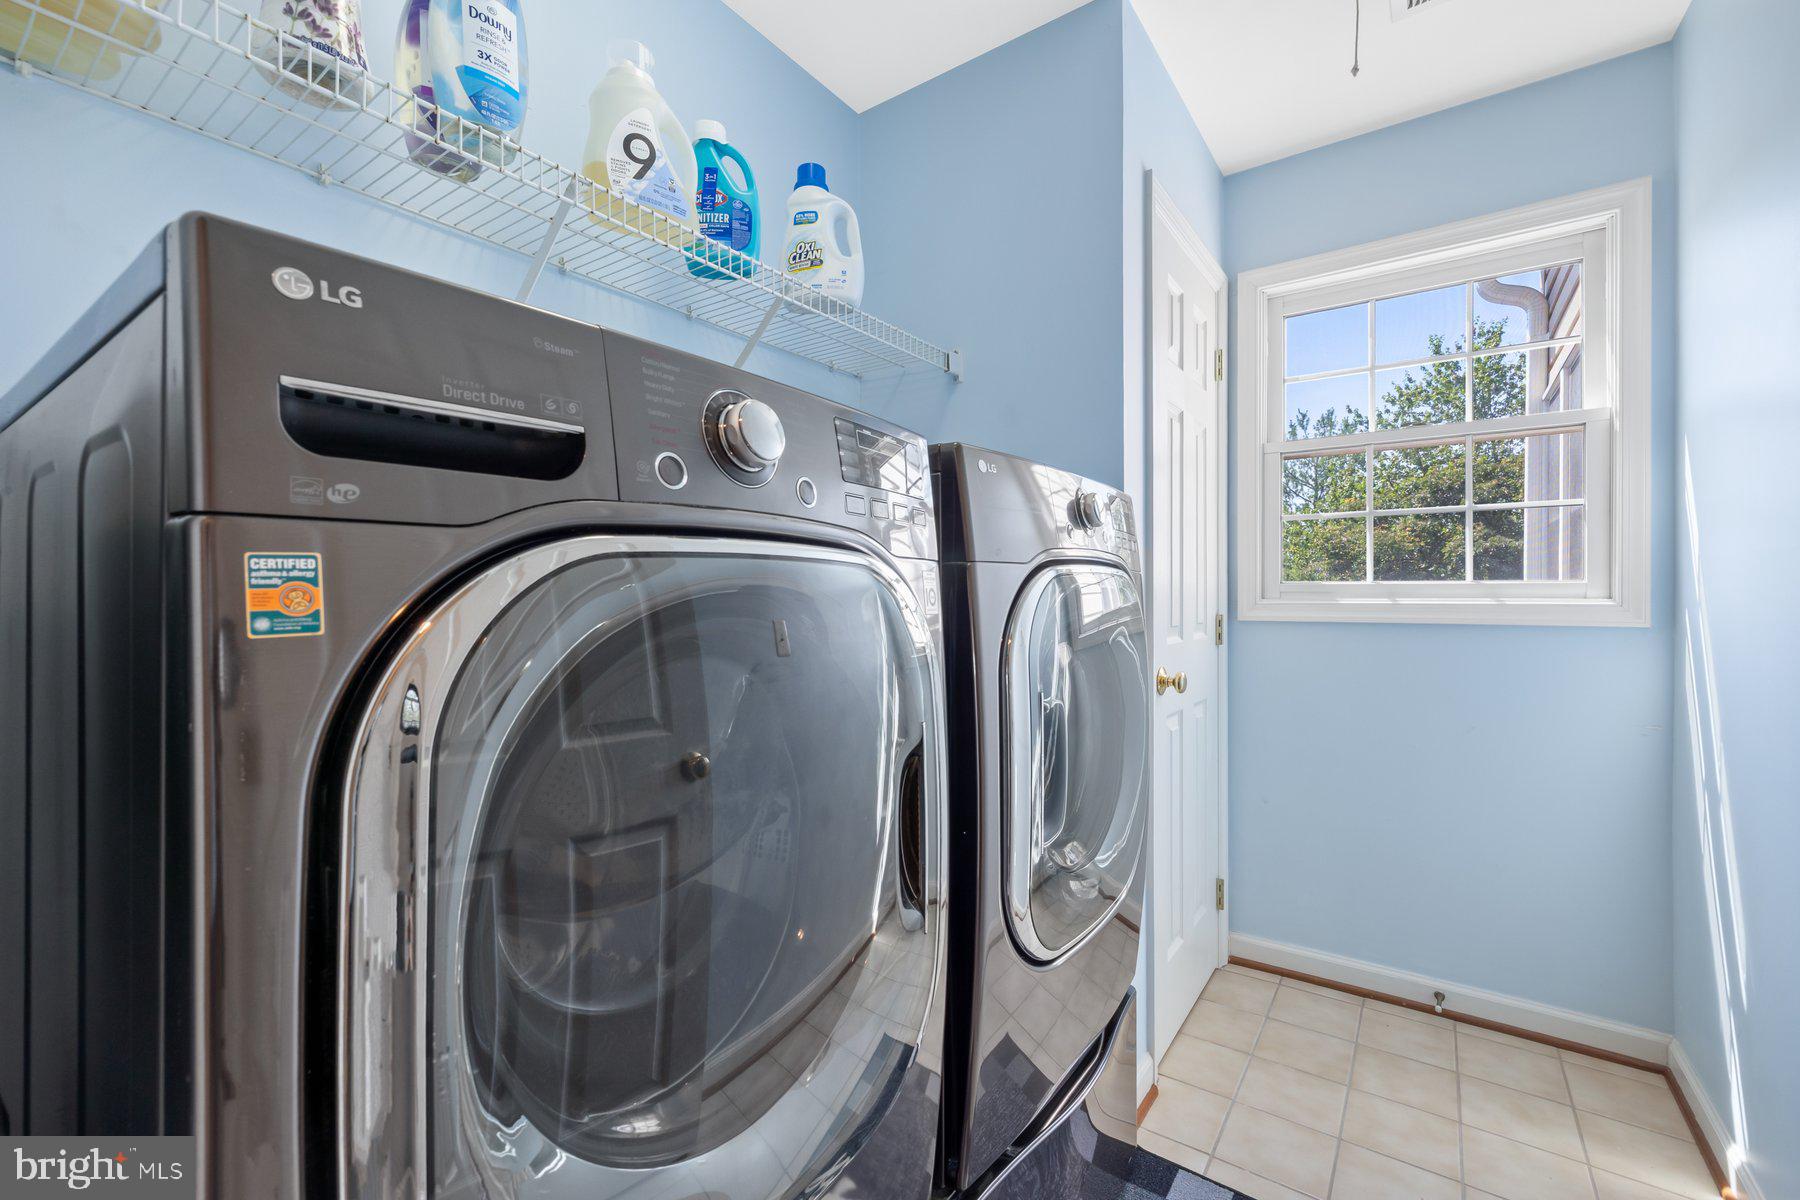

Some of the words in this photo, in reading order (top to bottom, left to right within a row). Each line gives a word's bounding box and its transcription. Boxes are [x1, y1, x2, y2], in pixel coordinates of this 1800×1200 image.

[468, 4, 512, 42] Downy
[480, 26, 499, 41] RINSE
[475, 33, 507, 53] REFRESH
[477, 49, 493, 63] 3X
[622, 132, 657, 180] 9
[698, 212, 730, 223] NITIZER
[796, 240, 816, 255] OXI
[788, 249, 823, 266] CLEAN
[320, 279, 363, 309] LG
[442, 375, 486, 390] Inverter
[442, 383, 487, 404] Direct
[489, 392, 526, 411] Drive
[249, 557, 317, 570] CERTIFIED
